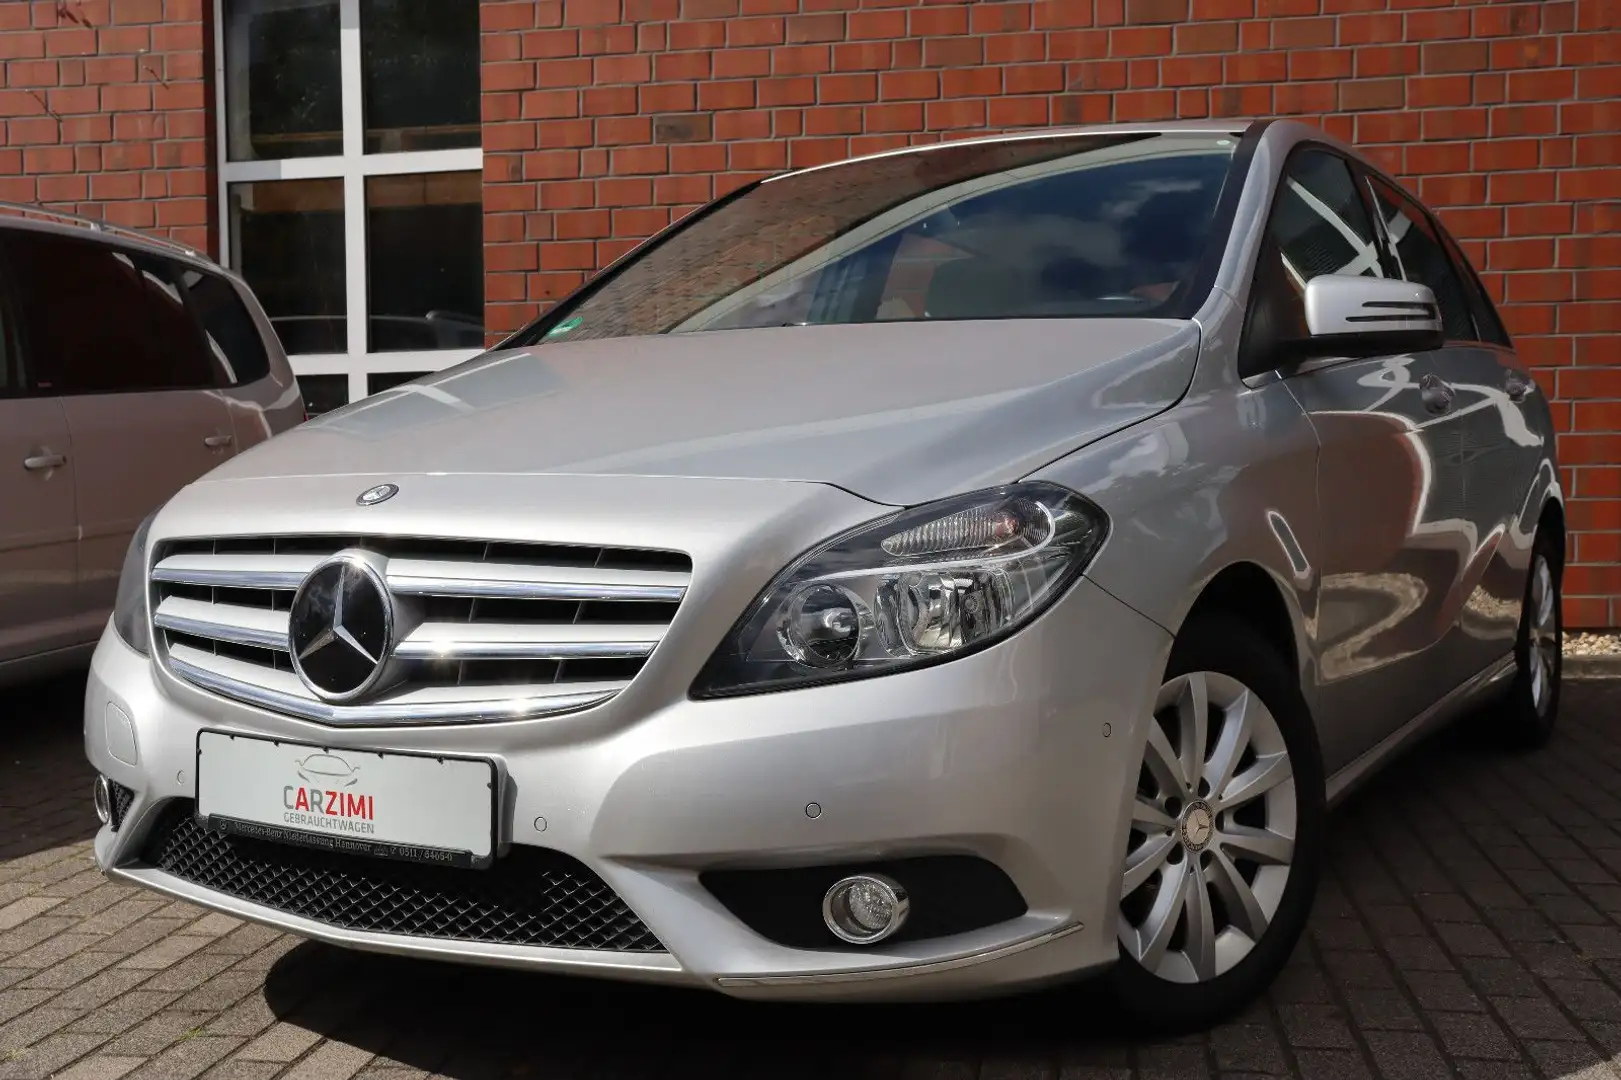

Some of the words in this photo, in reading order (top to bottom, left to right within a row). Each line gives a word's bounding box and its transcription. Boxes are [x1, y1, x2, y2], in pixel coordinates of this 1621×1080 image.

[283, 785, 374, 821] CARZIMI
[234, 821, 282, 838] Mercedes-Benz
[283, 830, 333, 848] Niederlassung
[335, 838, 372, 851] Hannover
[283, 812, 375, 834] GEBRAUCHTWAGEN
